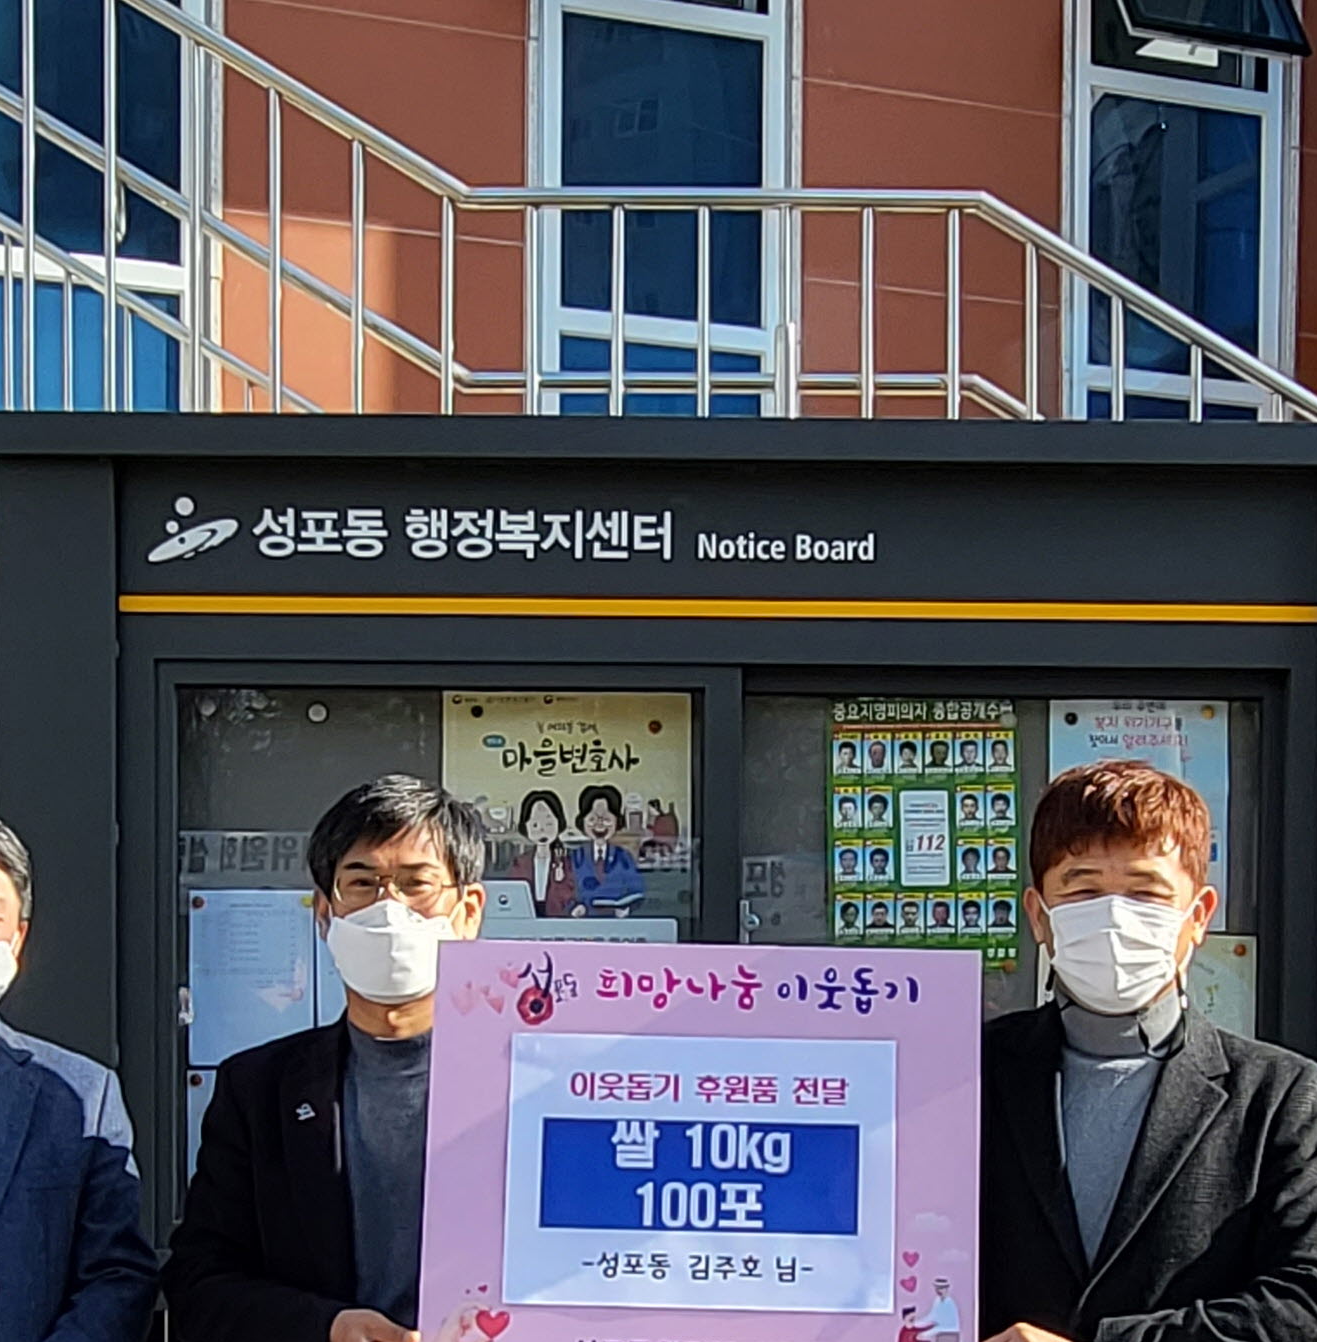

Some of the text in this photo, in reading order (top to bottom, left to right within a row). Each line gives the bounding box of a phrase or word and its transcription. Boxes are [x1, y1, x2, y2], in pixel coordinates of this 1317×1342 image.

[251, 508, 875, 562] 성포동 행정복지센터 Notice Board
[832, 702, 927, 722] 중요지명피의자
[502, 738, 640, 777] 마을변호사
[916, 833, 946, 852] 112
[596, 966, 764, 1011] 희망나눔
[777, 966, 920, 1014] 이웃돕기
[570, 1071, 850, 1106] 이웃돕기 후원품 전달
[610, 1119, 792, 1173] 쌀 10kg
[635, 1181, 765, 1230] 100포
[689, 1255, 763, 1282] 김주호
